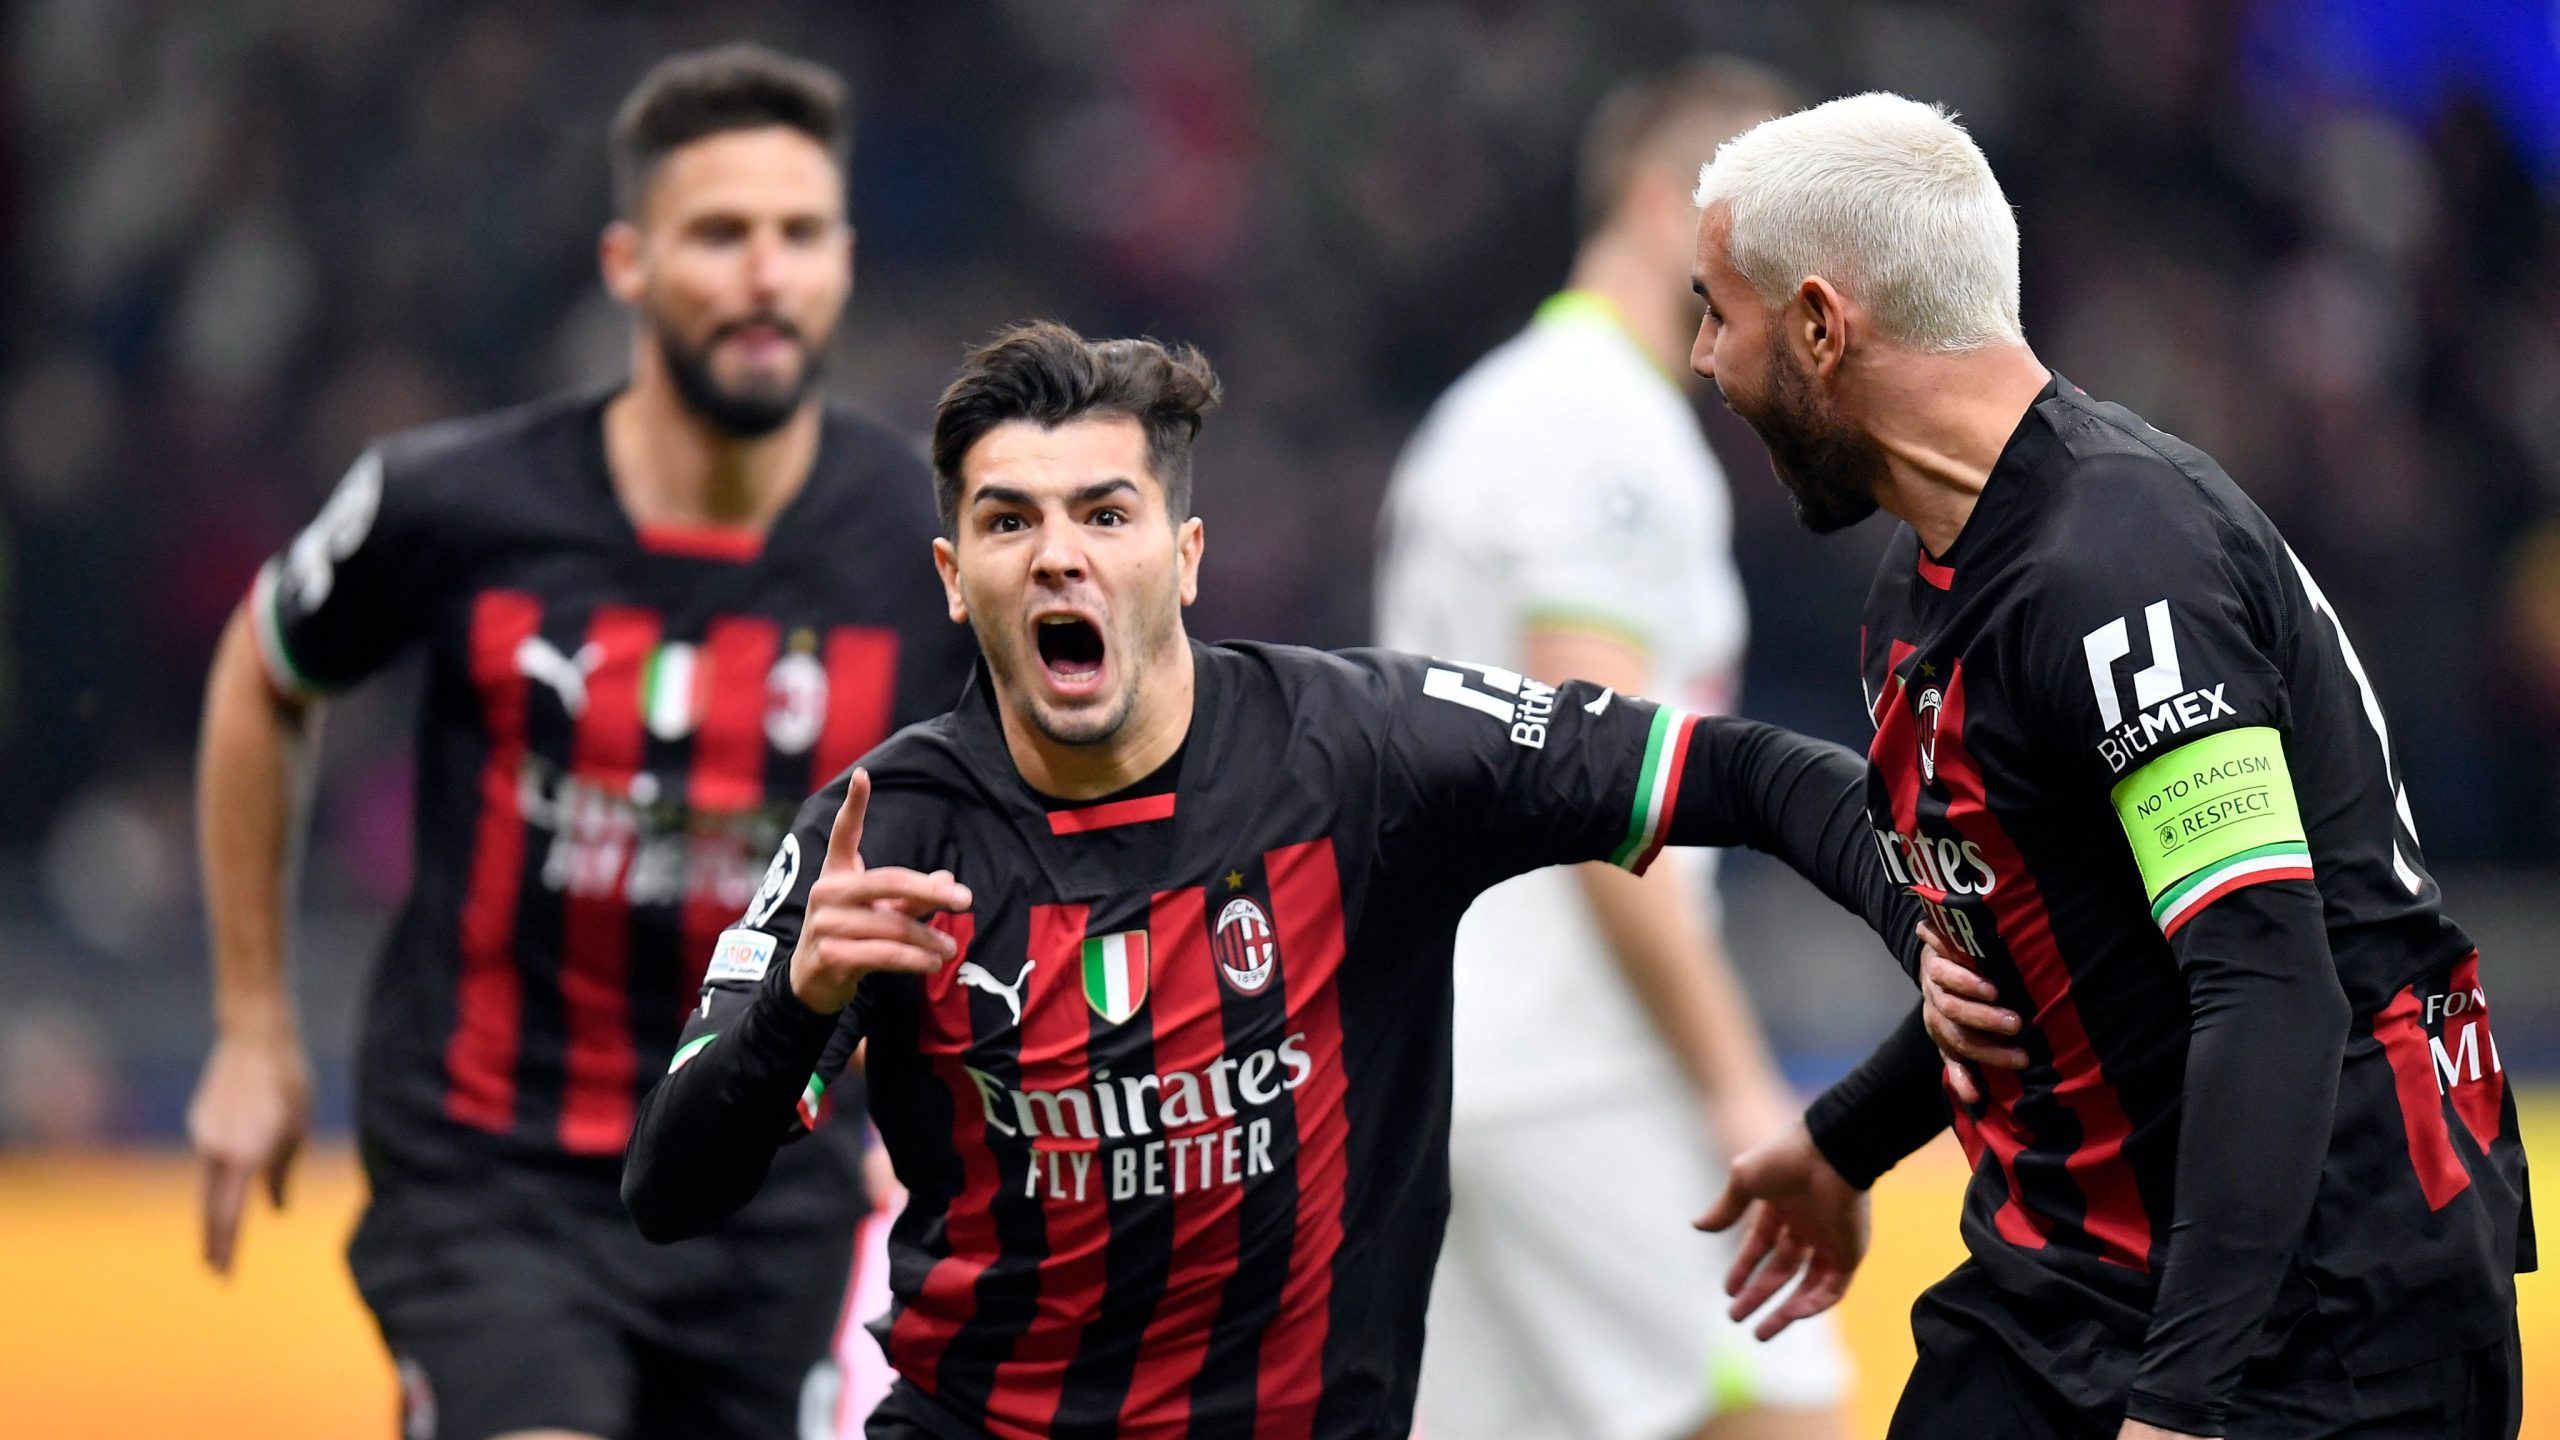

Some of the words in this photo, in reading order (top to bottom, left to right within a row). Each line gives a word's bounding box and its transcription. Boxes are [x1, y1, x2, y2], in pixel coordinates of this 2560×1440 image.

[2097, 682, 2237, 774] BitMEX
[2137, 795, 2161, 820] NO
[2162, 780, 2189, 803] TO
[2193, 756, 2271, 789] RACISM
[2182, 792, 2269, 836] RESPECT
[965, 1032, 1312, 1139] Emirates
[1025, 1147, 1092, 1201] FLY
[1112, 1117, 1275, 1200] BETTER
